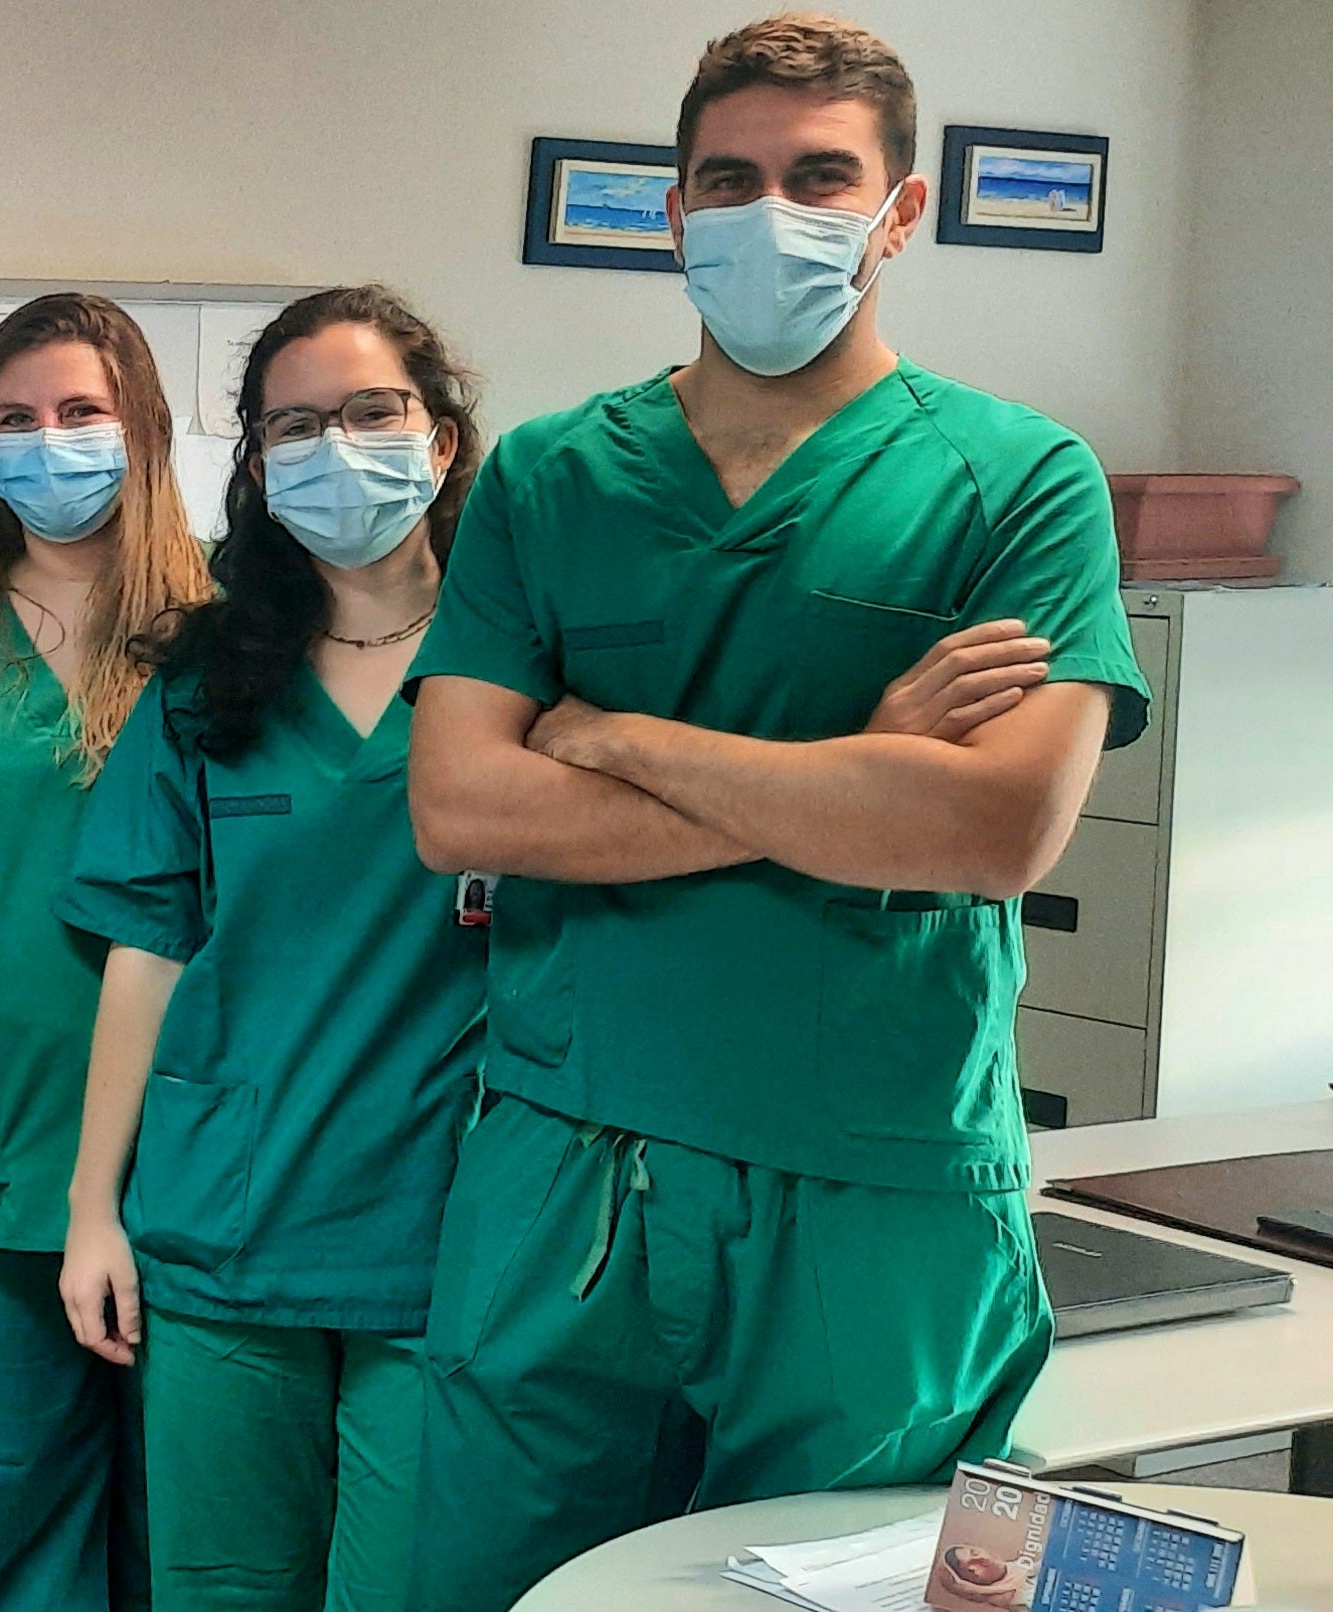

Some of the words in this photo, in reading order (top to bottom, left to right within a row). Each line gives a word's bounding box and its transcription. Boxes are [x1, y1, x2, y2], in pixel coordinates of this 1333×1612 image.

[961, 1478, 991, 1513] 20
[991, 1485, 1023, 1521] 20
[1017, 1490, 1051, 1571] Dignidad
